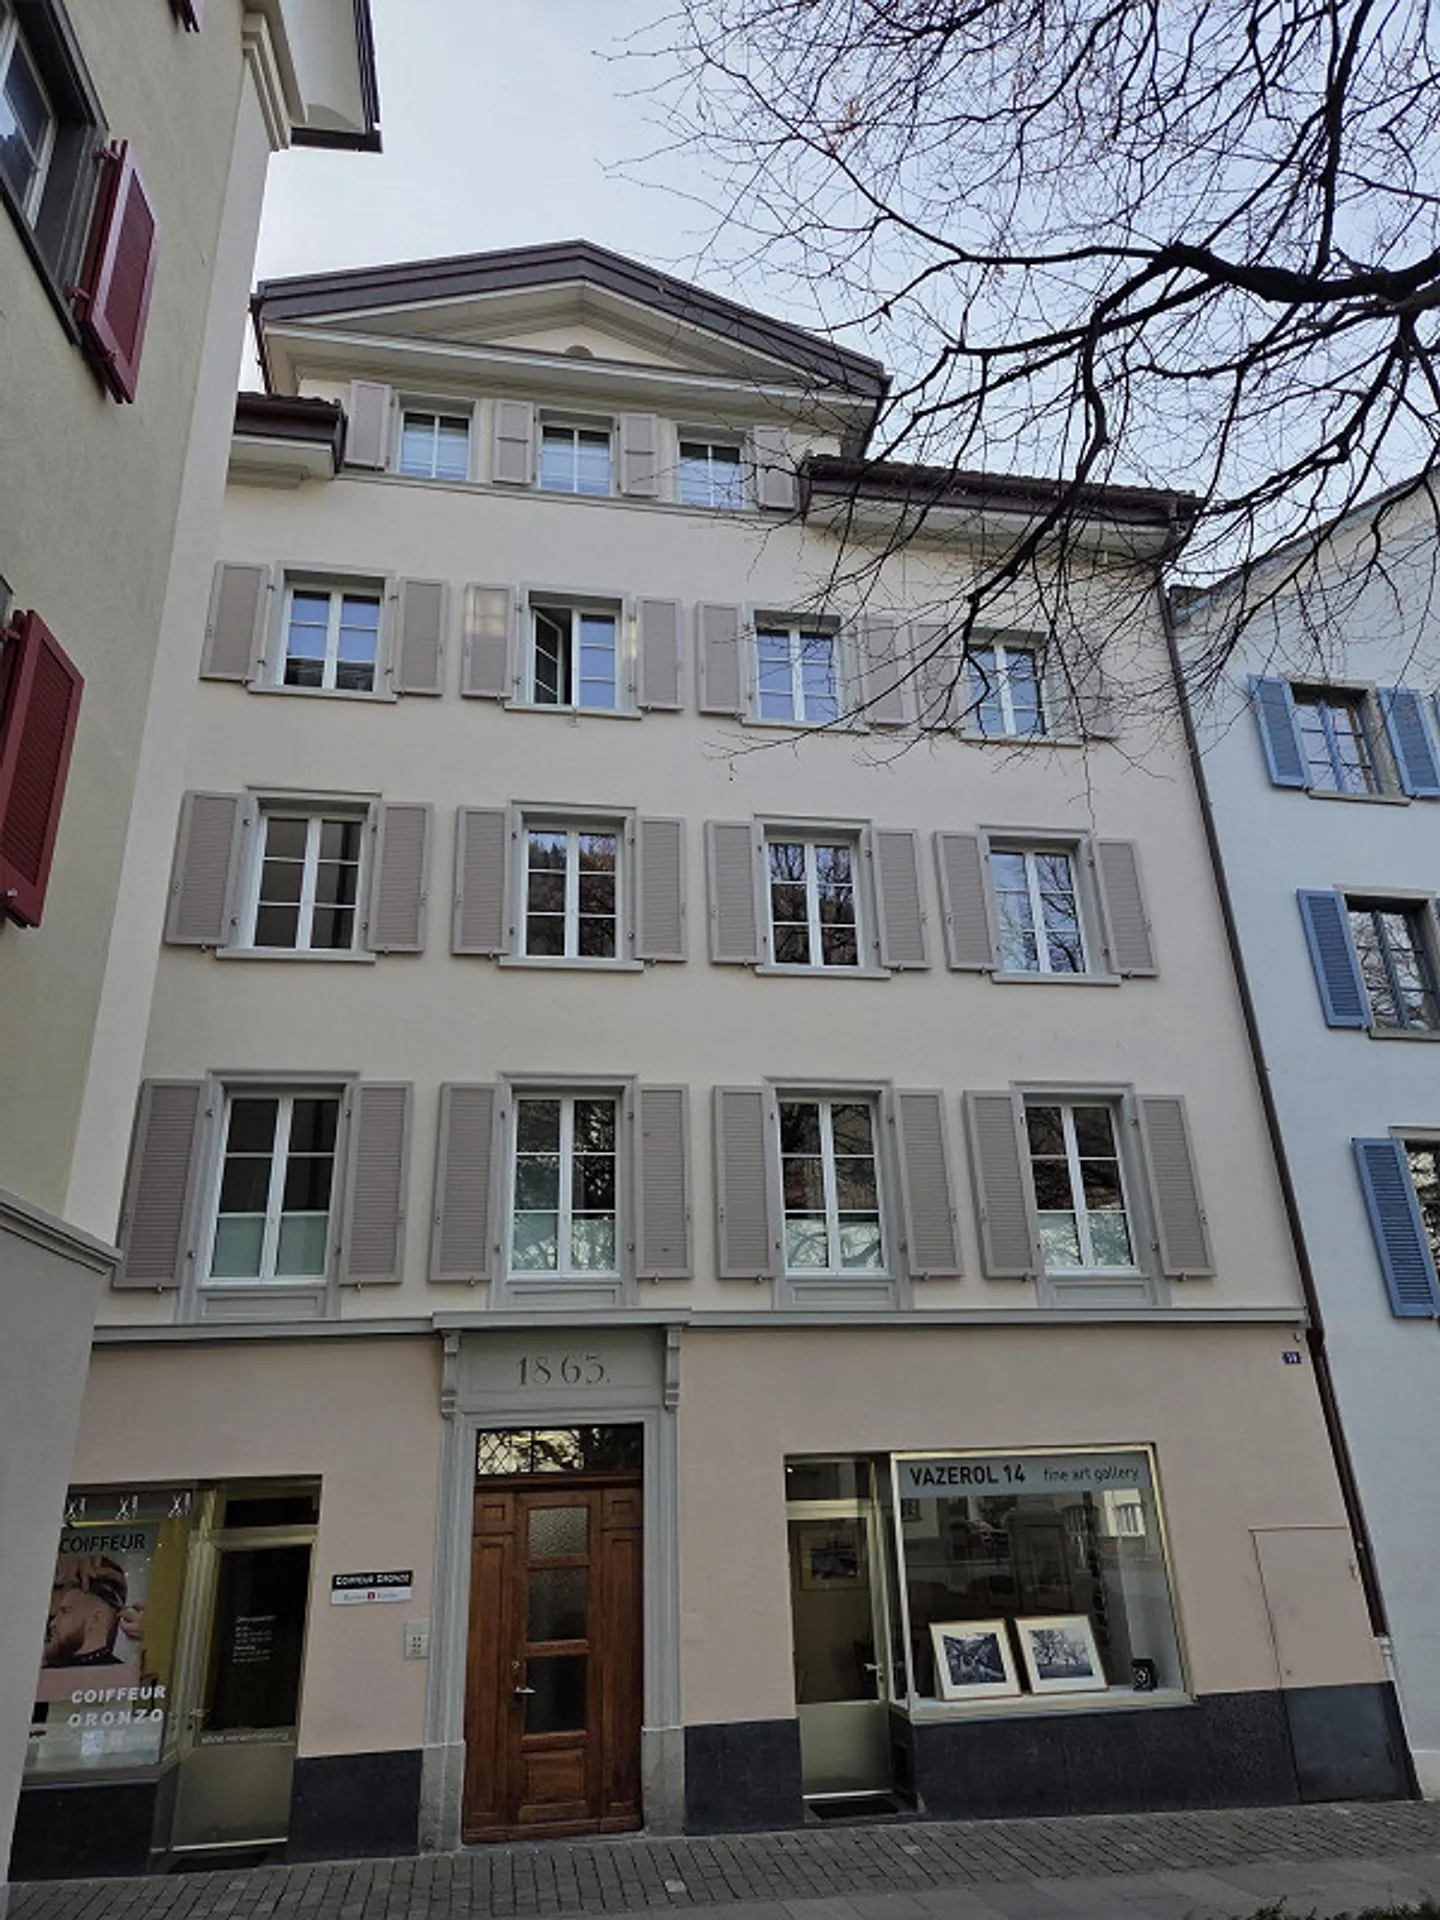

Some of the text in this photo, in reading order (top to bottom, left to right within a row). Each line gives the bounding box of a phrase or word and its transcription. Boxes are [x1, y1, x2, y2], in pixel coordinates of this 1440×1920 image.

[909, 1464, 1139, 1486] VAZEROL 14 fine art gallery
[60, 1533, 145, 1554] COIFFEUR
[71, 1685, 167, 1703] COIFFEUR
[68, 1709, 164, 1728] ORONZO
